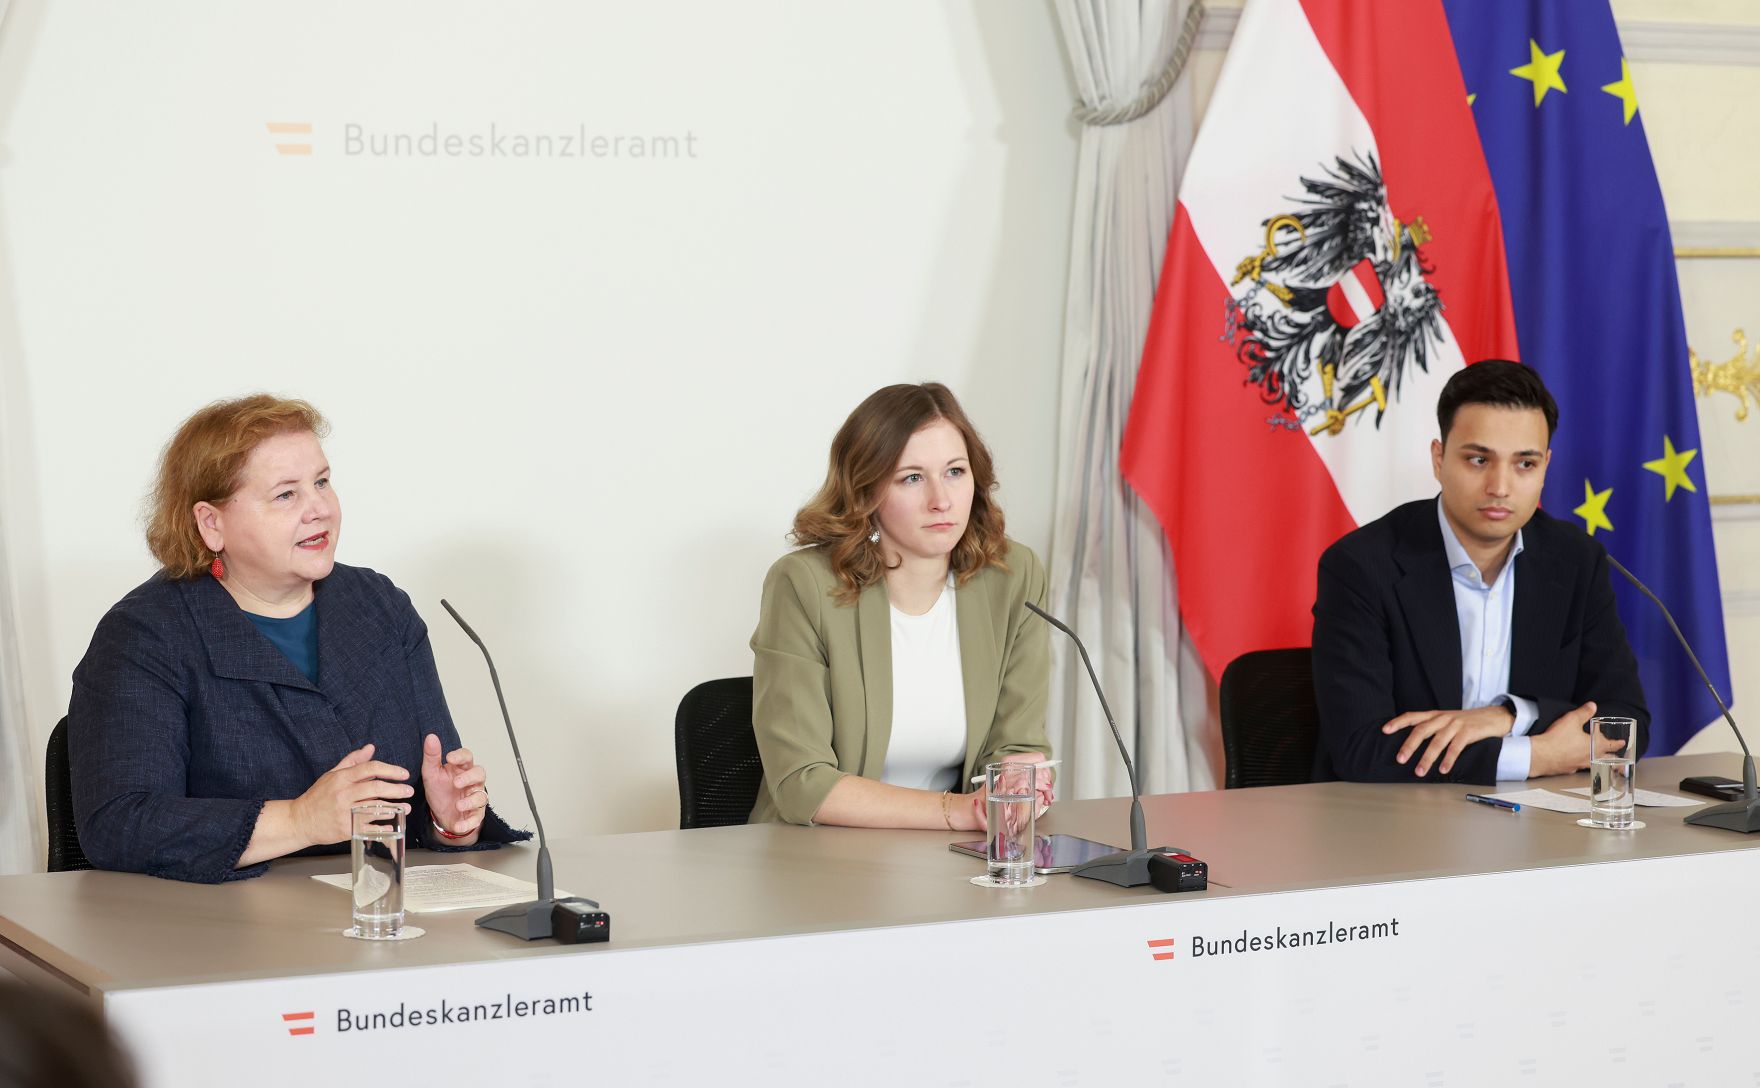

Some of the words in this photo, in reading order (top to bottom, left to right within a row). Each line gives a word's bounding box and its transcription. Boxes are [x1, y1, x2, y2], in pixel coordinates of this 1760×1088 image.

[343, 122, 698, 158] Bundeskanzleramt
[1192, 917, 1400, 958] Bundeskanzleramt
[337, 991, 593, 1033] Bundeskanzleramt
